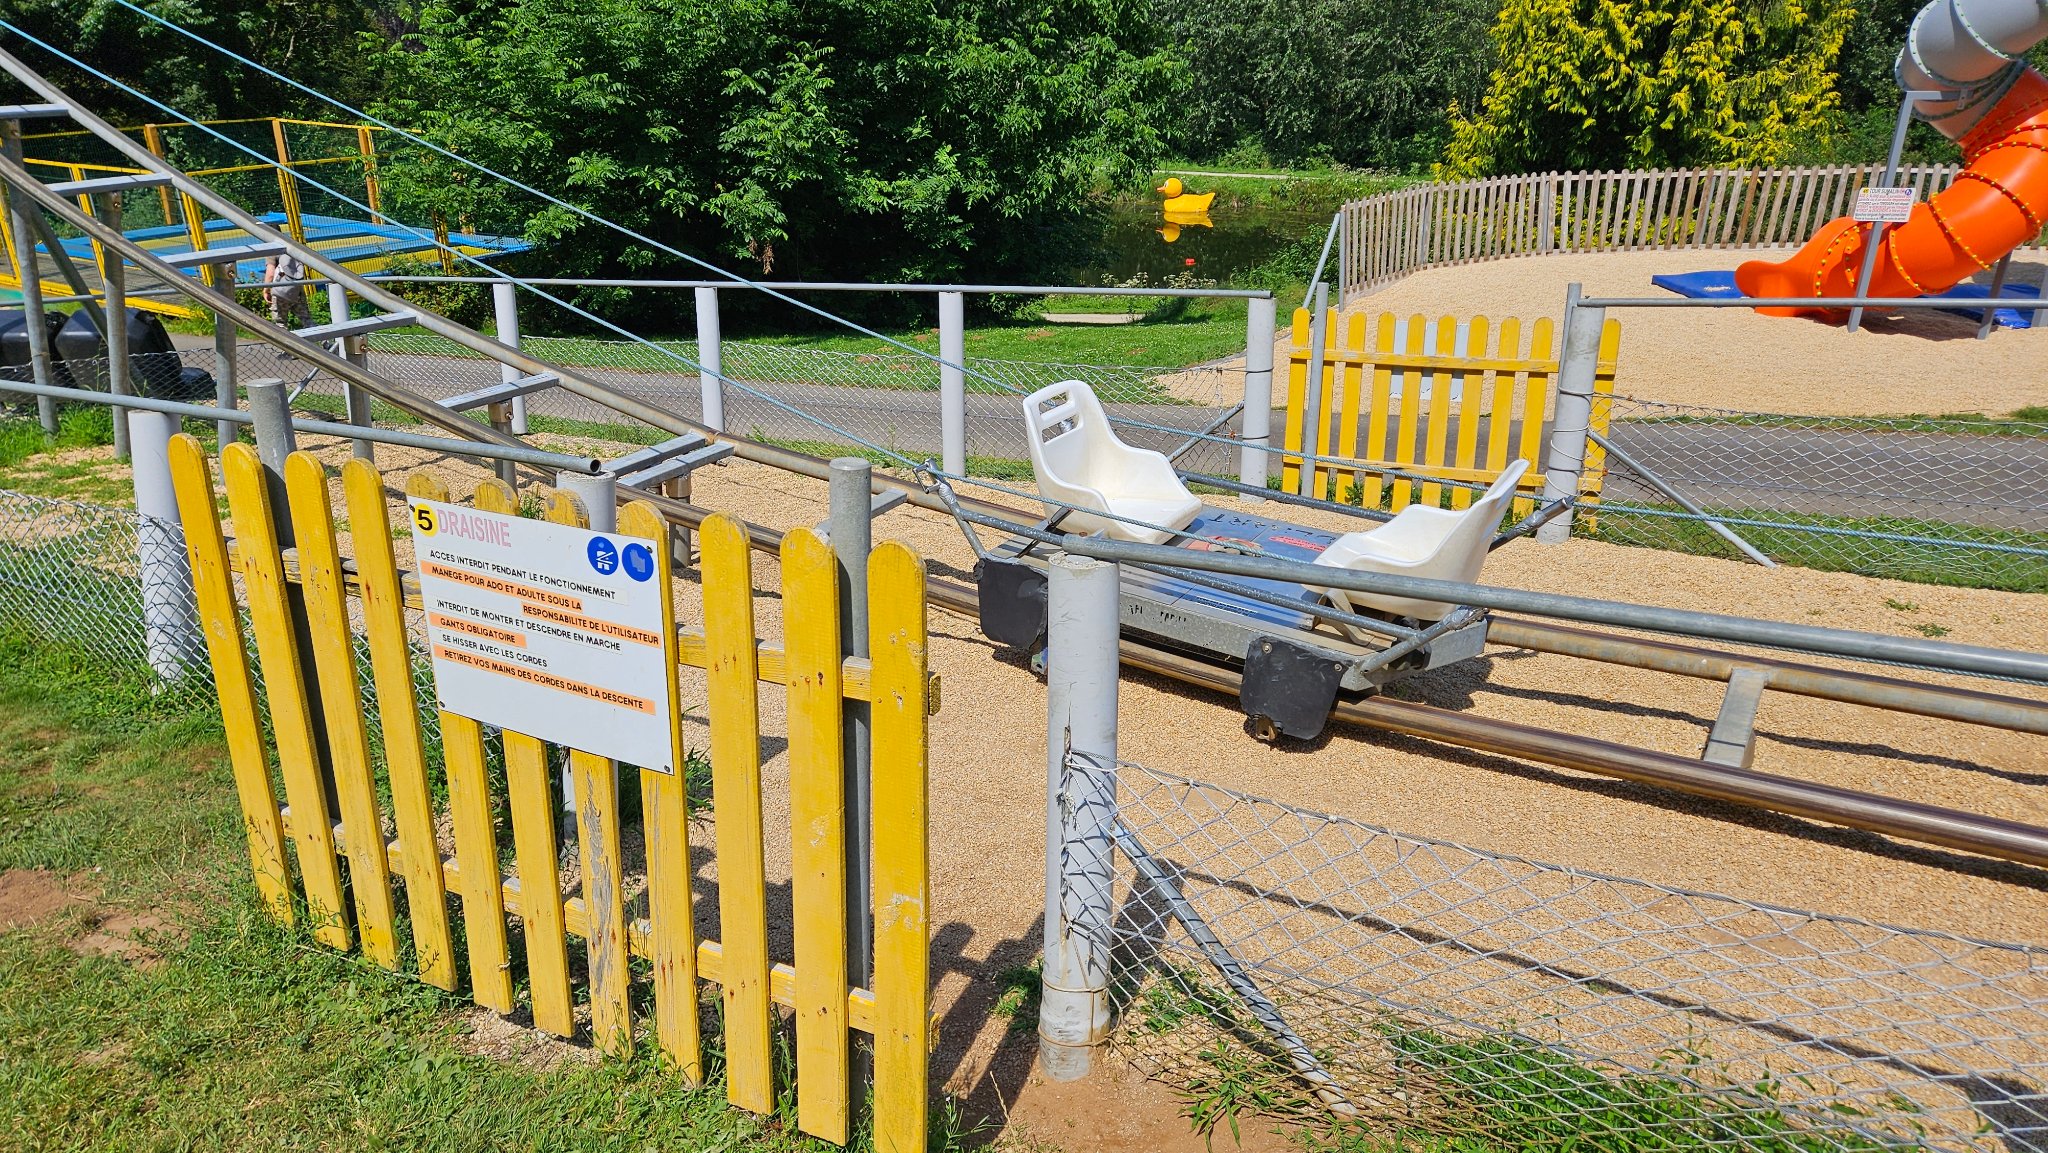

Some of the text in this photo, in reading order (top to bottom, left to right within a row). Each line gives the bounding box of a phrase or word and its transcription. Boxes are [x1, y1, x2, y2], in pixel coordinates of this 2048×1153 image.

[418, 509, 511, 547] 5 DRAISINE
[430, 549, 615, 599] ACCES INTERDIT PENDANT LE FONCTIONNEMENT
[432, 566, 583, 611] MANEGE POUR ADO ET ADULTE SOUS LA
[437, 599, 621, 652] INTERDIT DE MONTER ET DESCENDRE EN MARCHE
[440, 618, 516, 644] GANTS OBLIGATOIRE
[523, 605, 660, 646] RESPONSABILITE DE L'UTILISATEUR
[442, 634, 548, 668] SE HISSER AVEC LES CORDES
[444, 650, 644, 710] RETIREZ VOS MAINS DES CORDES DANS LA DESCENTE
